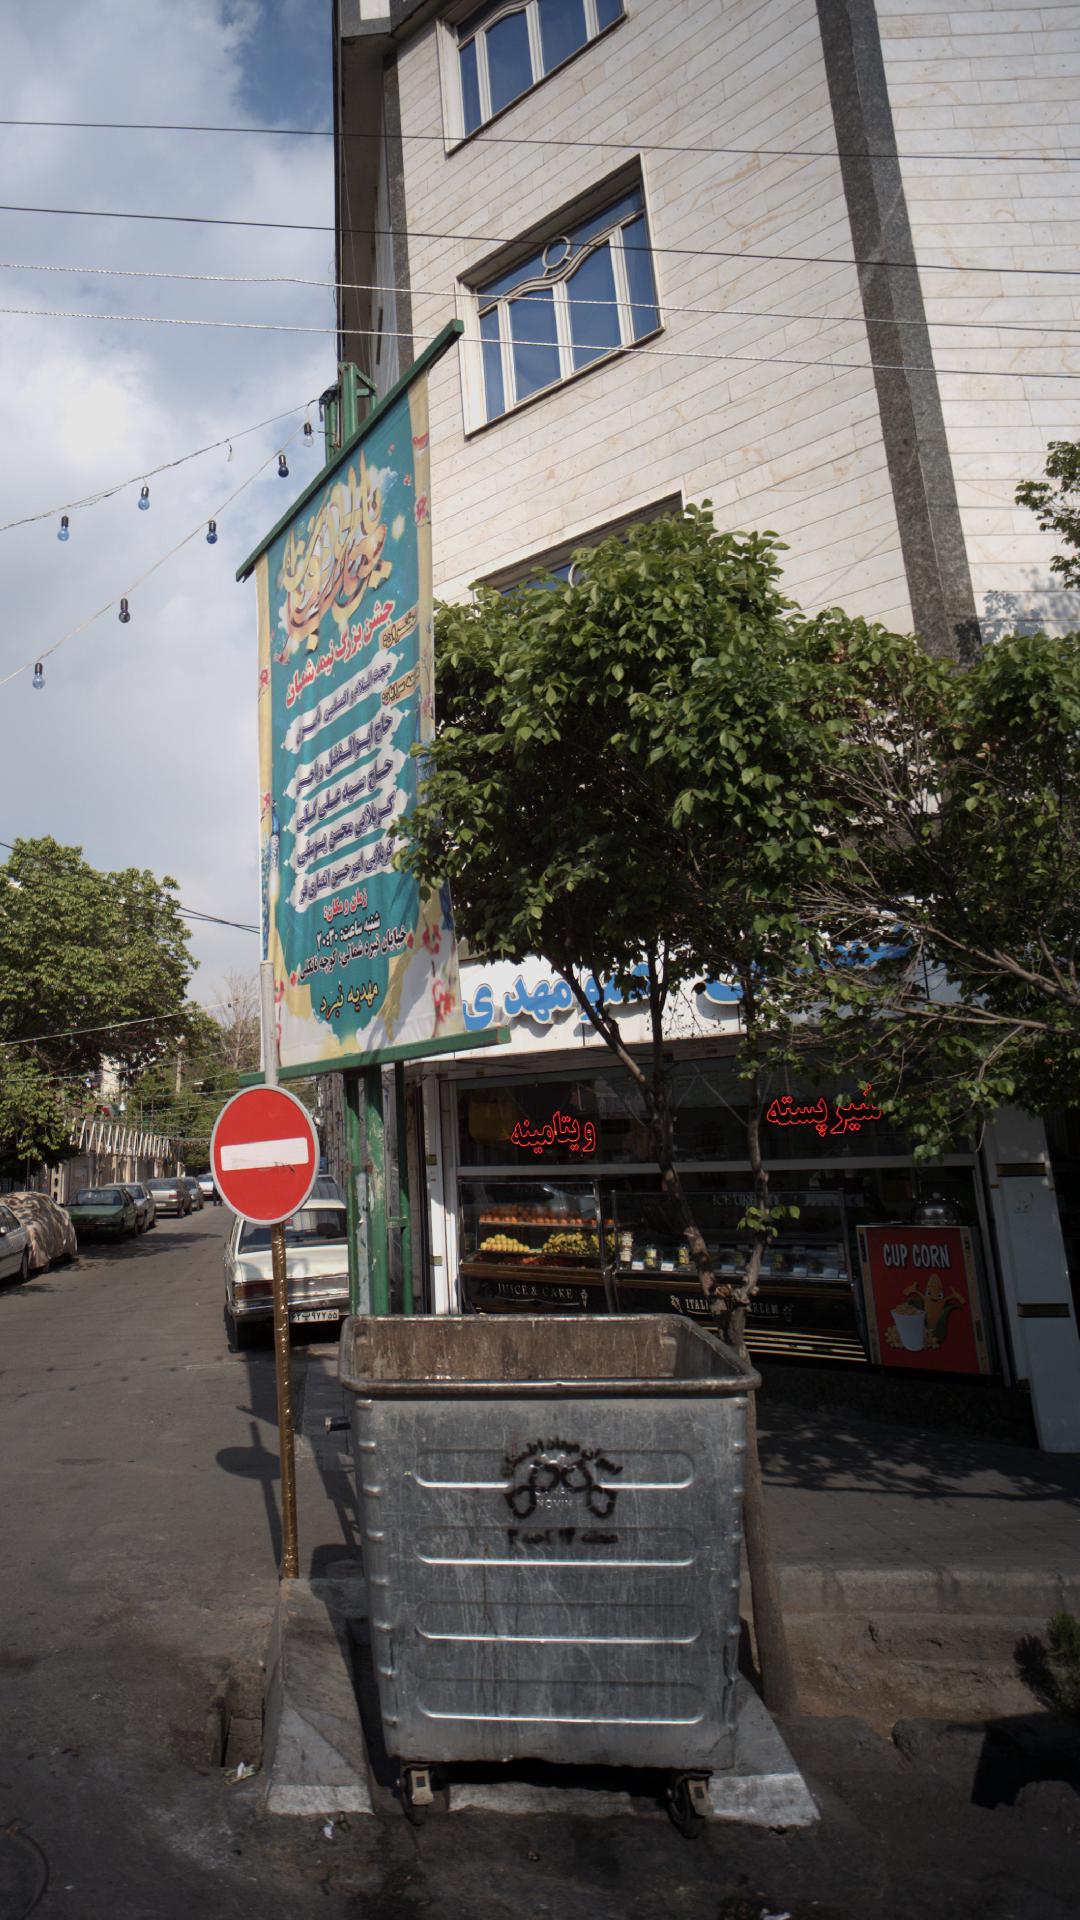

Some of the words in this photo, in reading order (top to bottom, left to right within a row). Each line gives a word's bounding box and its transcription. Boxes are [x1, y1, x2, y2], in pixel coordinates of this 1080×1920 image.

[362, 599, 396, 646] جشن
[335, 618, 362, 665] بزرگ
[375, 711, 394, 744] حاج
[326, 721, 374, 776] ابوالفضل
[343, 774, 367, 804] سید
[367, 758, 394, 792] حاج
[319, 787, 342, 820] علی
[355, 790, 396, 838] کربلایی
[329, 822, 354, 852] محسن
[364, 837, 395, 873] کربلایی
[350, 887, 368, 911] زمان
[339, 917, 363, 941] ساعت:
[364, 911, 380, 935] شنبه
[381, 924, 407, 954] خیابان
[364, 932, 380, 959] نبرد
[319, 981, 344, 1020] نبرد
[347, 980, 379, 1012] مهدیه
[766, 1096, 829, 1138] پسته
[829, 1081, 884, 1135] شیر
[510, 1109, 597, 1154] ویتامینه
[882, 1243, 907, 1268] CUP
[912, 1244, 950, 1269] CORN
[498, 1283, 529, 1296] JUICE
[543, 1287, 574, 1299] CAKE
